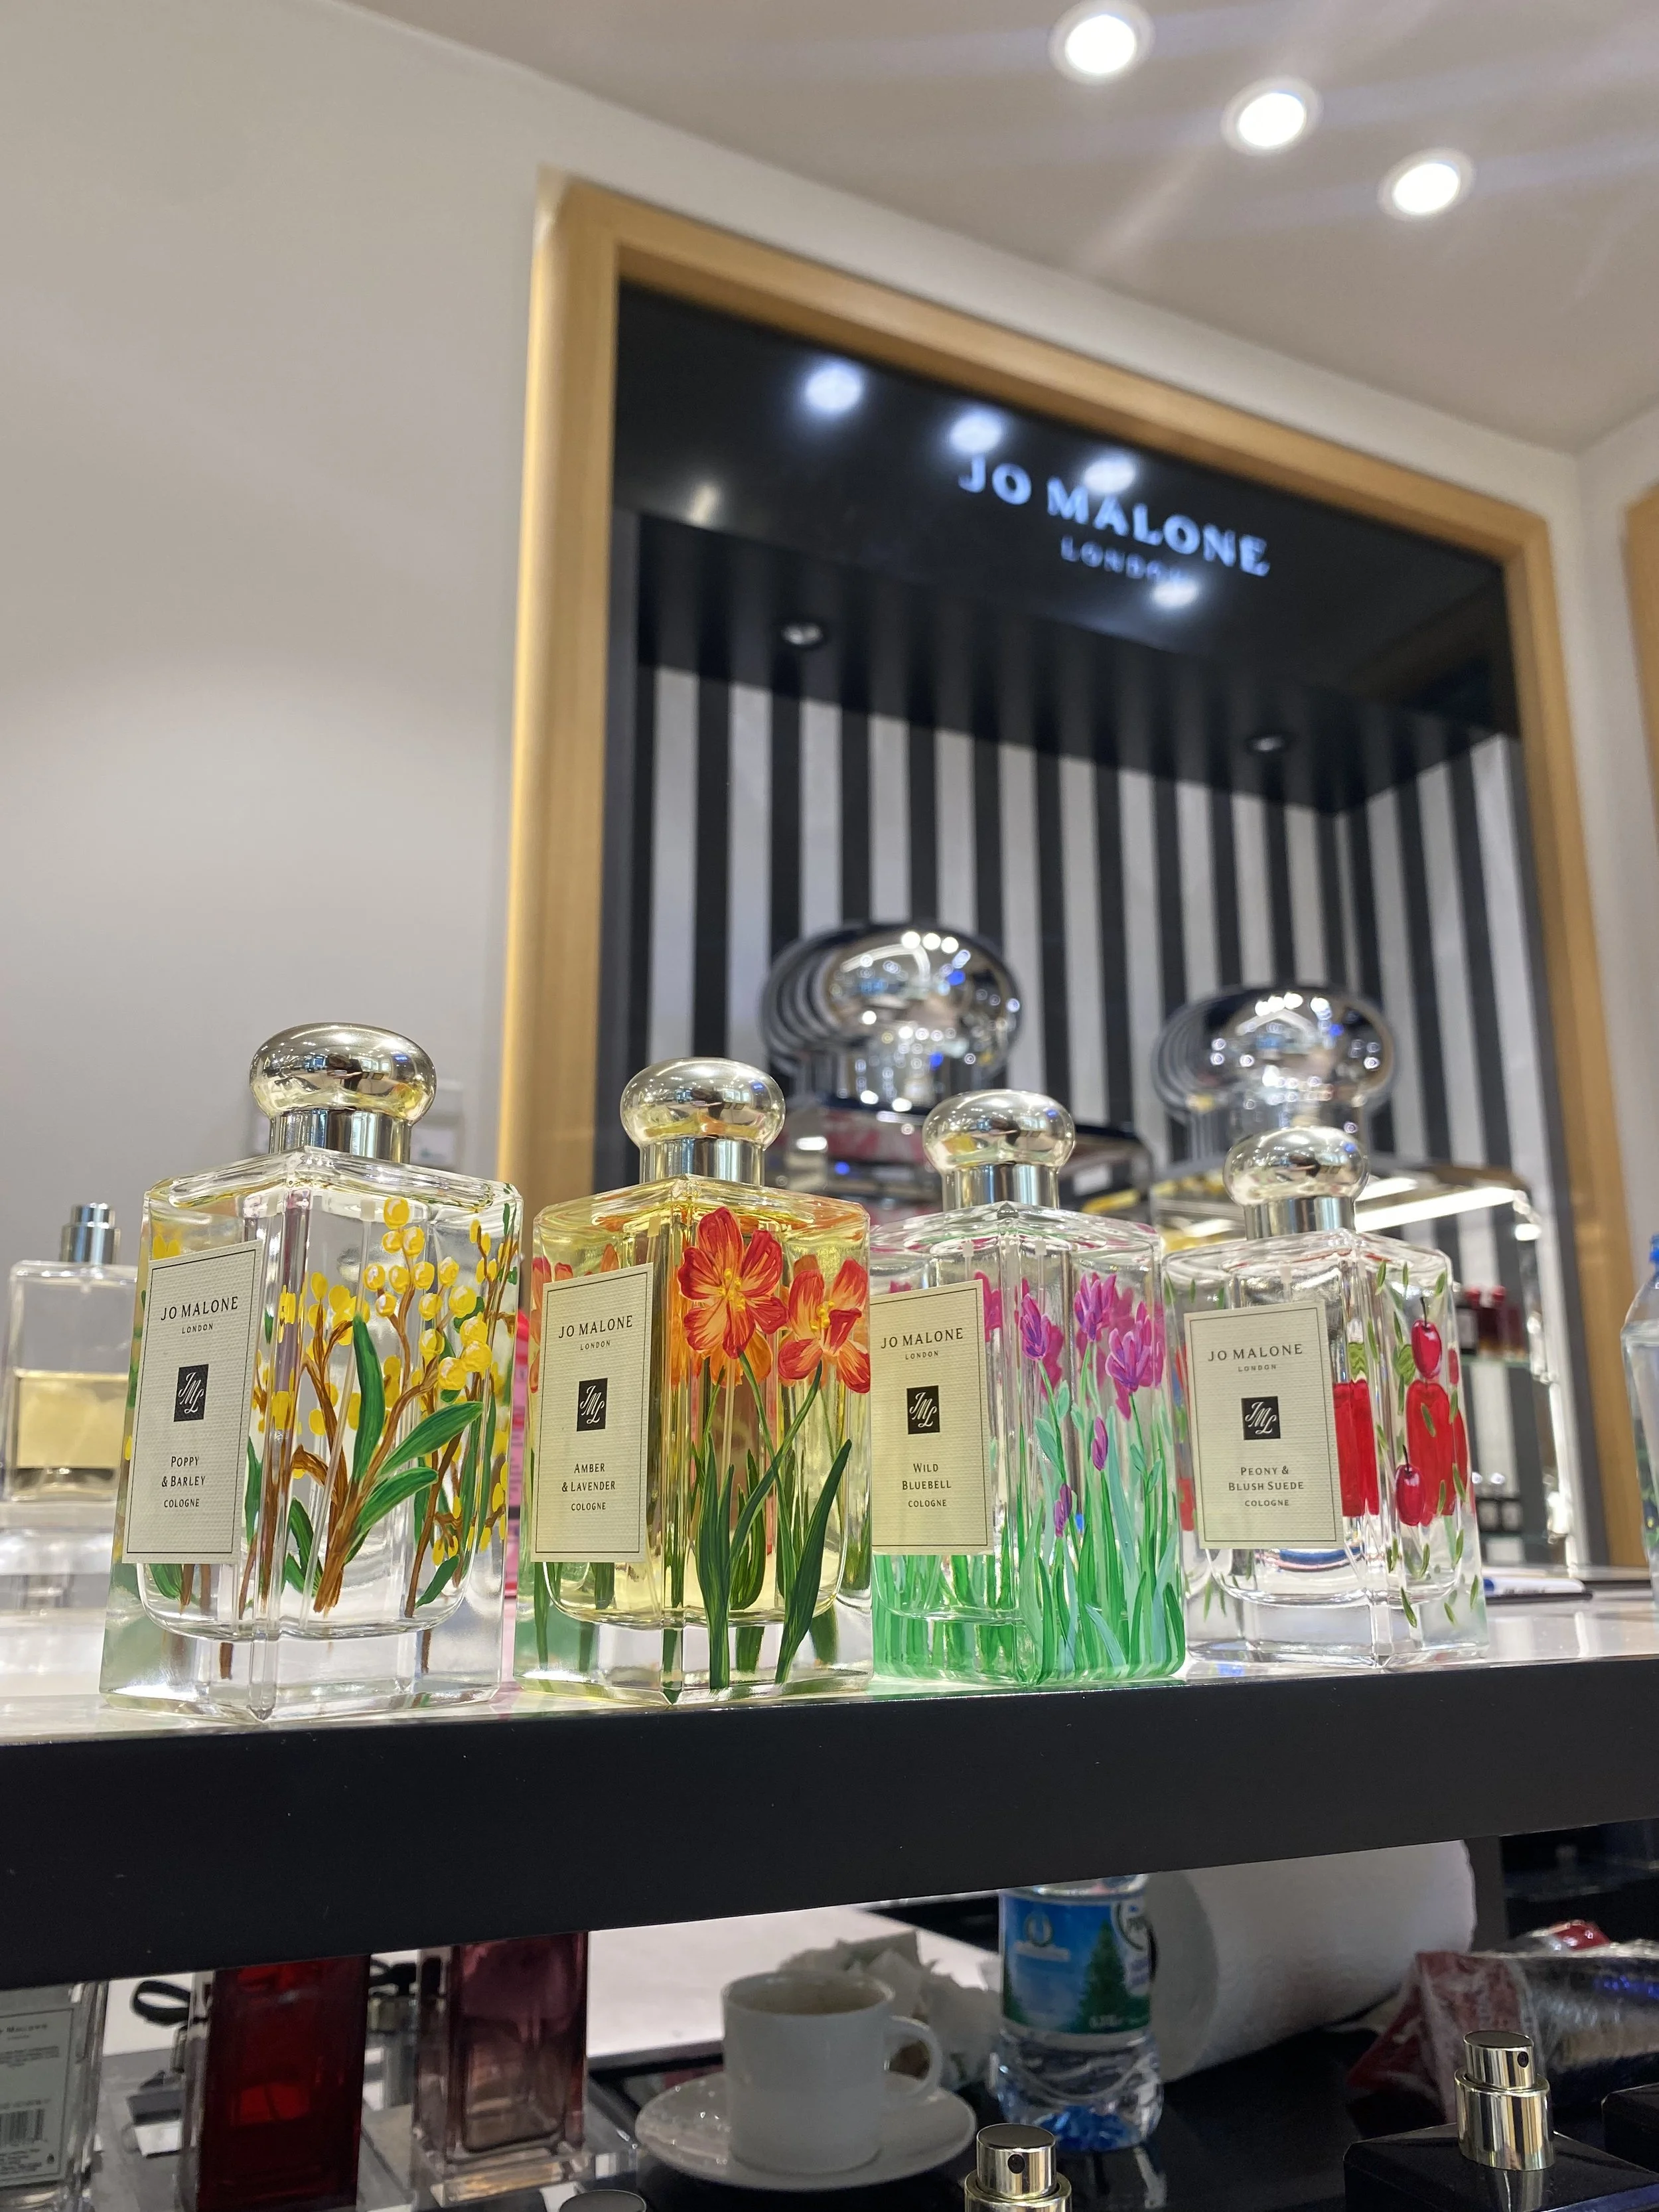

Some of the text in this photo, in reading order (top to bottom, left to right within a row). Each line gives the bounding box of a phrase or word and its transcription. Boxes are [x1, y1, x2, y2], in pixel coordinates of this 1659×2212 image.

[958, 453, 1270, 577] JO MALONE
[161, 1295, 238, 1321] JO MALONE
[181, 1323, 214, 1334] LONDON
[558, 1315, 632, 1339] JO MALONE
[881, 1327, 963, 1349] JO MALONE
[580, 1340, 611, 1351] LONDON
[905, 1350, 938, 1361] LONDON
[1208, 1343, 1303, 1362] JO MALONE
[1238, 1364, 1277, 1372] LONDON
[171, 1456, 200, 1467] POPPY
[573, 1463, 605, 1474] AMBER
[912, 1463, 938, 1473] WILD
[1240, 1465, 1289, 1476] PEONY &
[161, 1475, 206, 1487] & BARLEY
[902, 1480, 952, 1491] BLUEBELL
[1228, 1481, 1304, 1491] BLUSH SUEDE
[561, 1481, 616, 1493] & LAVENDER
[163, 1498, 200, 1508] COLOGNE
[571, 1502, 606, 1511] COLOGNE
[908, 1499, 947, 1508] COLOGNE
